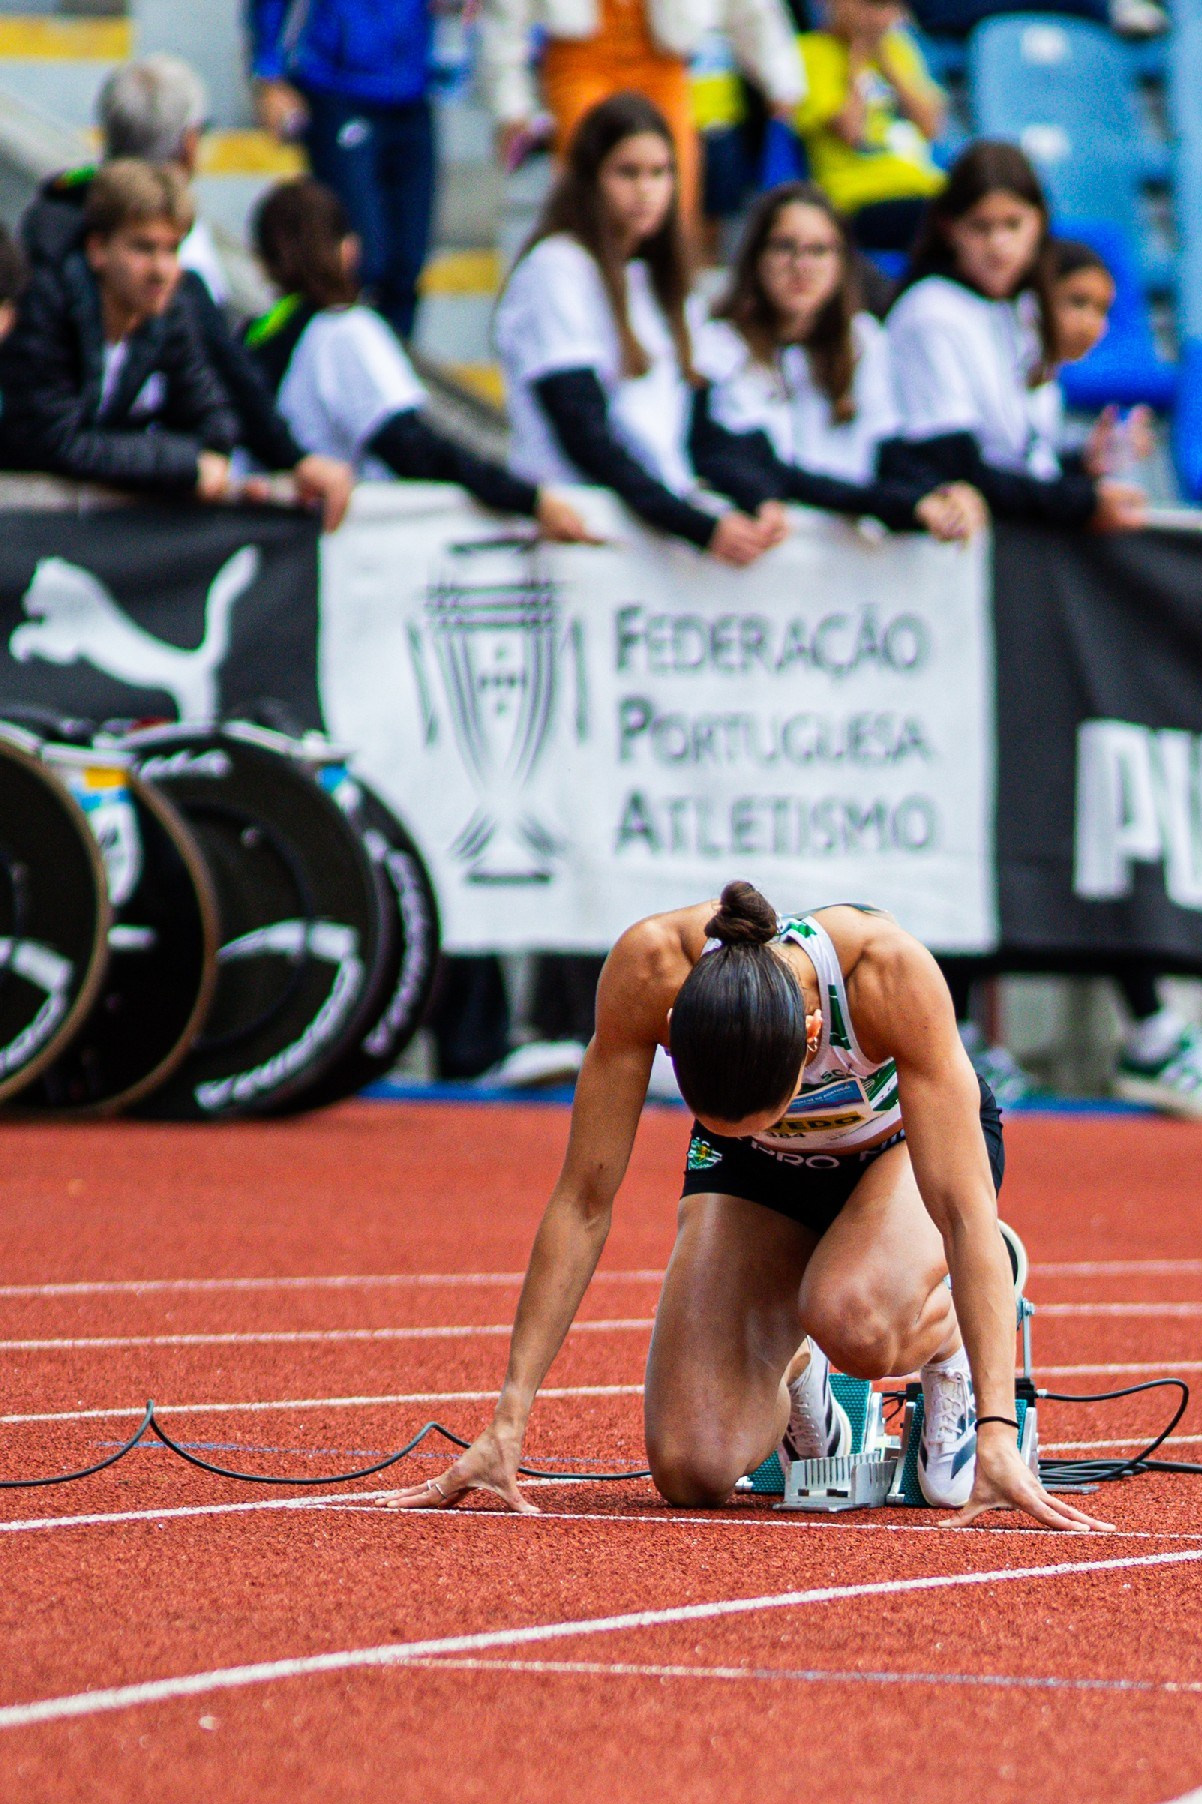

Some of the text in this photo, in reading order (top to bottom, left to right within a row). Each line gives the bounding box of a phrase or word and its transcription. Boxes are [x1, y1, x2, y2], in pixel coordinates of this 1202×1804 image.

[614, 602, 932, 686] FEDERAÇÃO
[617, 694, 936, 768] PORTUGUESA
[612, 788, 938, 858] ATLETISMO
